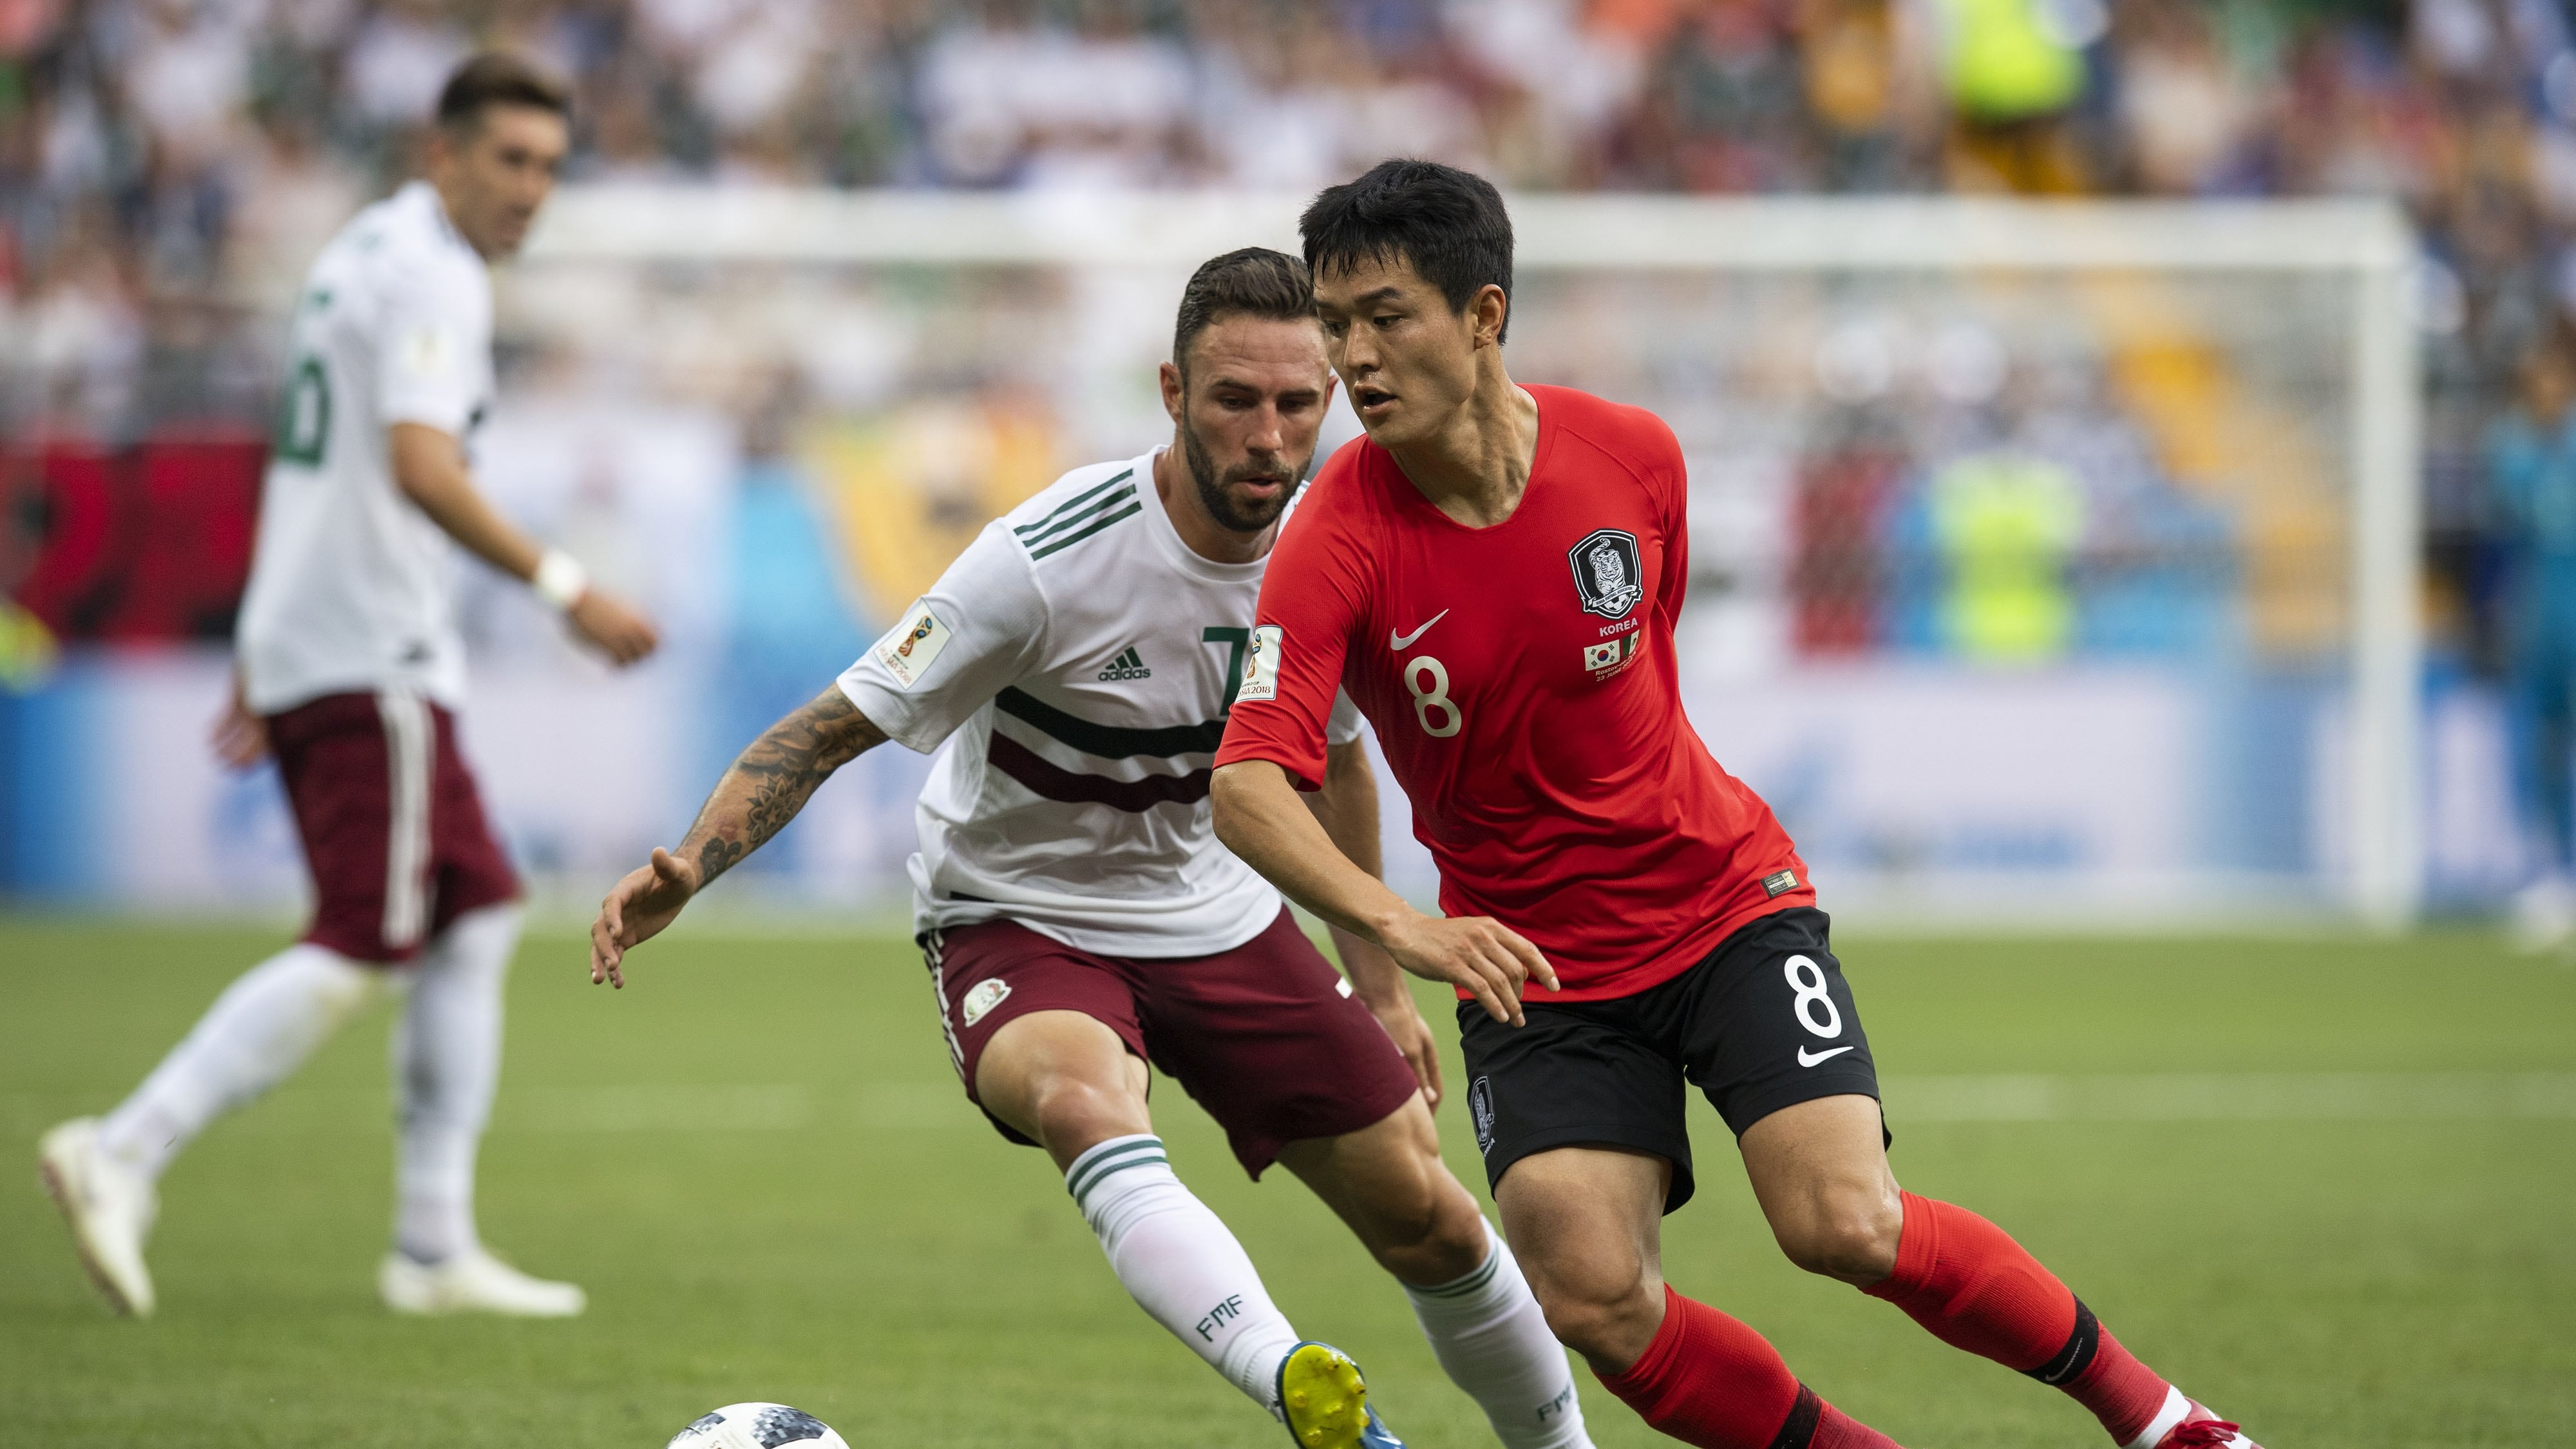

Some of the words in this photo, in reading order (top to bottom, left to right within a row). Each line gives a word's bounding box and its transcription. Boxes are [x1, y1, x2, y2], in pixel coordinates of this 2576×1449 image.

[1599, 618, 1638, 637] KOREA
[1098, 667, 1151, 681] adidas
[1202, 627, 1250, 716] 7
[1251, 685, 1271, 694] 2018
[1404, 656, 1463, 738] 8
[1784, 954, 1842, 1039] 8
[1196, 1294, 1243, 1343] FMF
